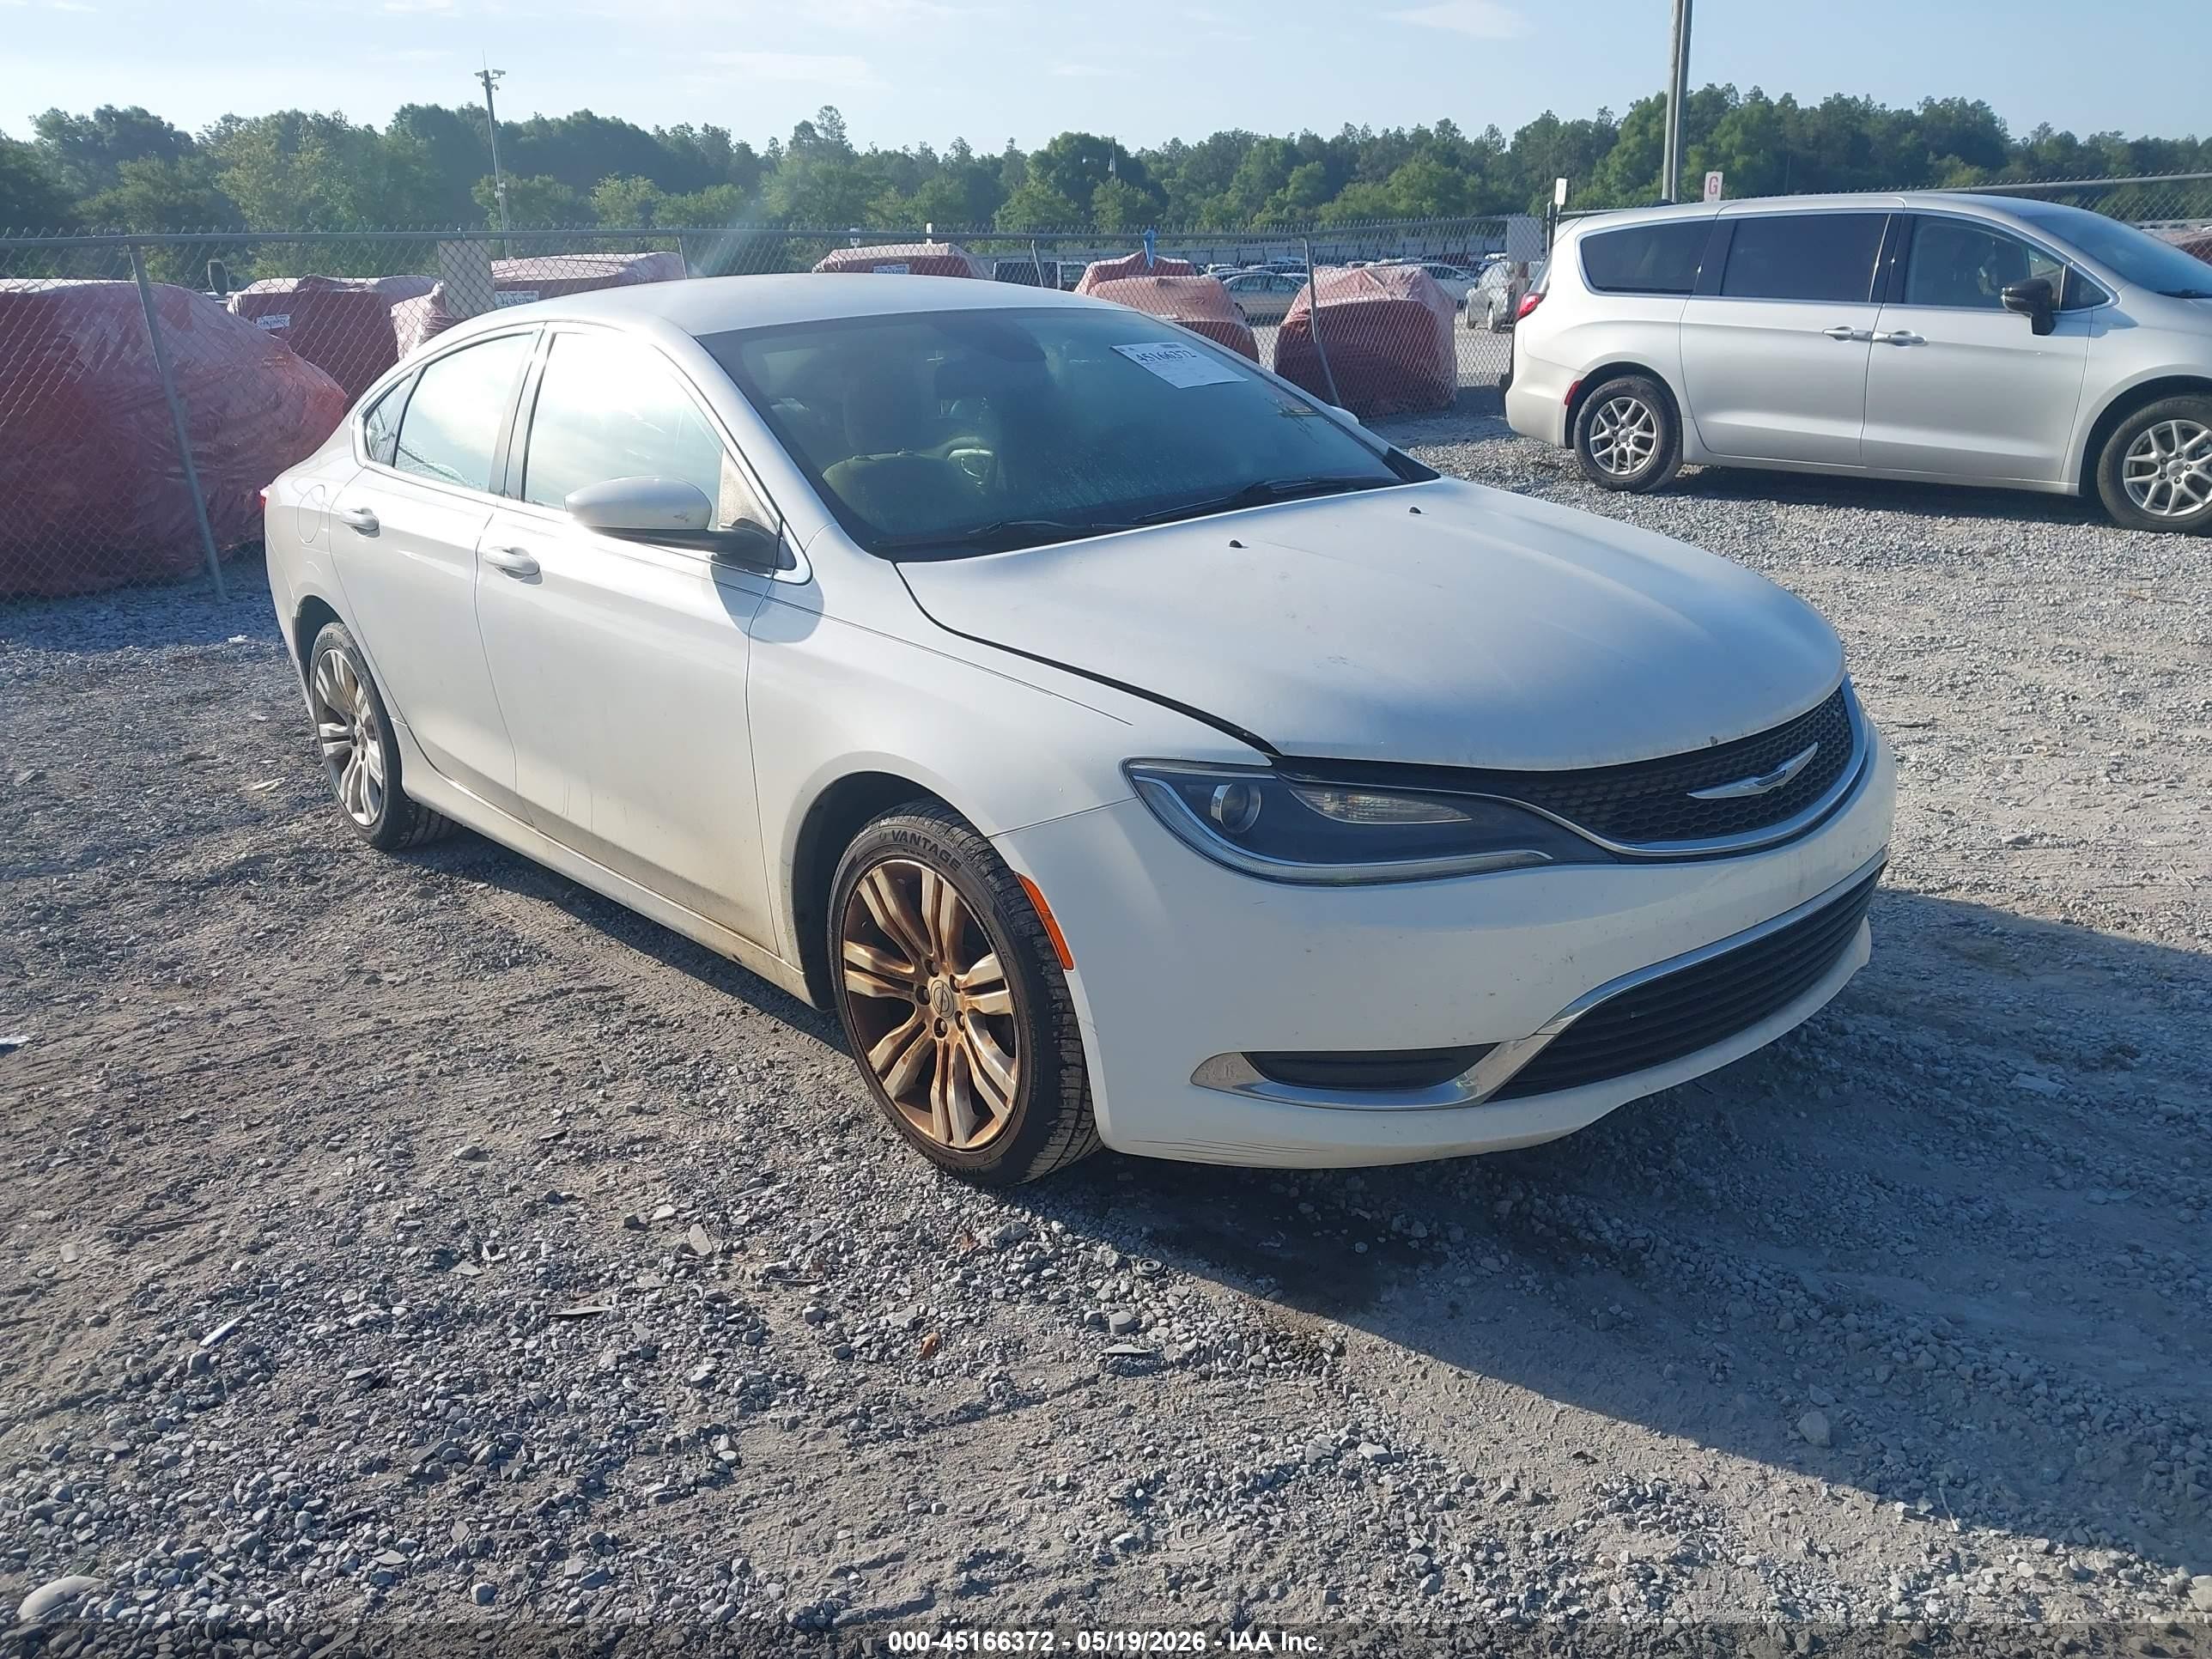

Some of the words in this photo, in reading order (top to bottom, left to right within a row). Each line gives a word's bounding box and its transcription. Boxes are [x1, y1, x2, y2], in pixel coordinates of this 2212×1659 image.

[1709, 176, 1718, 195] G
[1136, 350, 1197, 362] 45166372
[891, 830, 963, 872] VANTAGE
